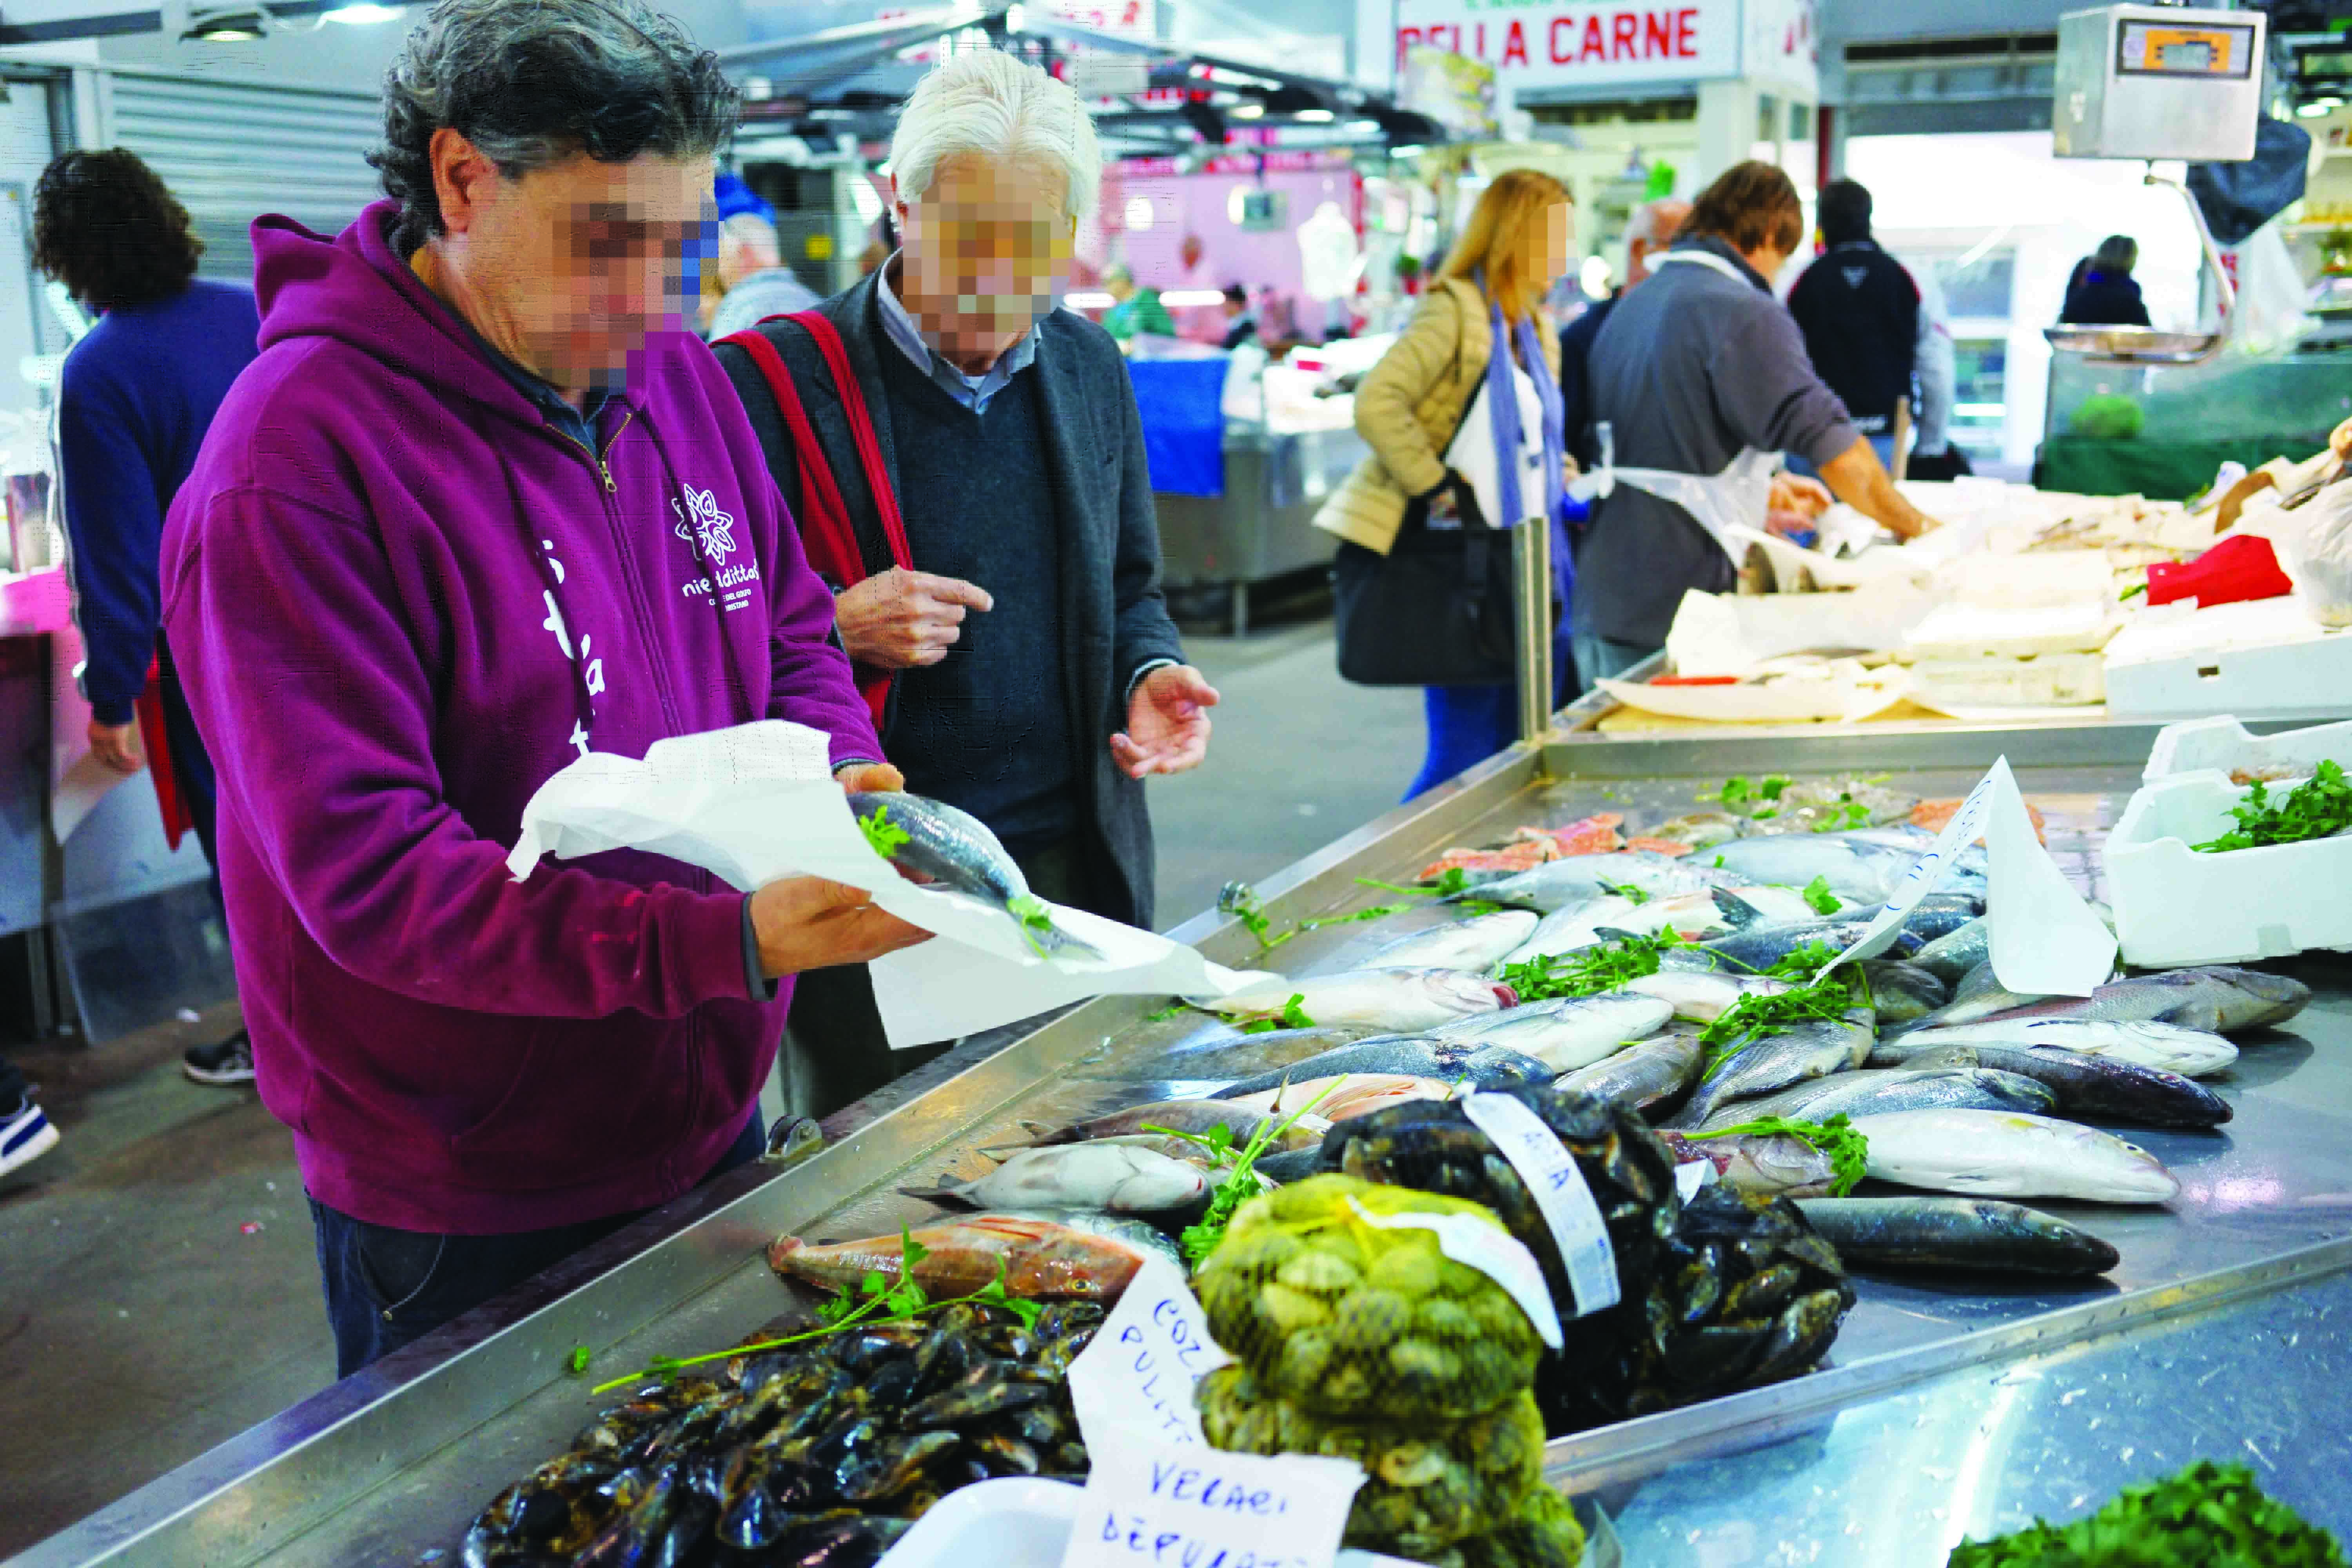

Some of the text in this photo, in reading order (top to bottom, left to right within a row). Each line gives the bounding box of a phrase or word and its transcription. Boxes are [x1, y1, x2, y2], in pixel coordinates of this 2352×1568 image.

[1550, 9, 1698, 64] CARNE
[682, 558, 760, 597] nieditta
[725, 599, 749, 612] RISTANO
[1153, 1298, 1201, 1382] COZ
